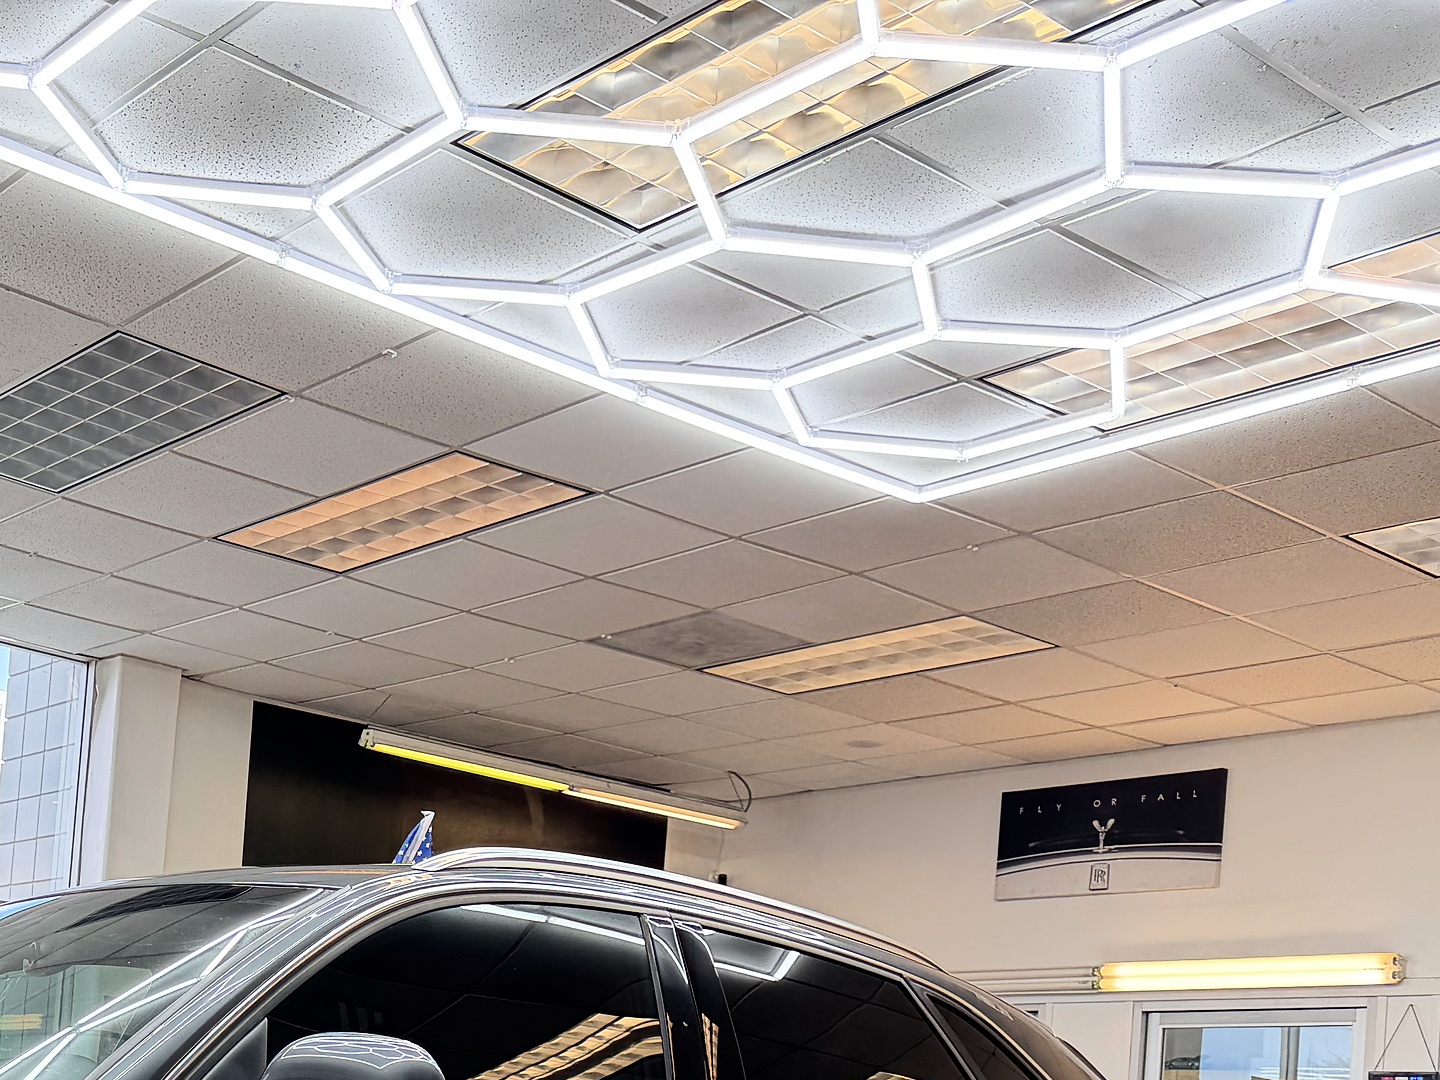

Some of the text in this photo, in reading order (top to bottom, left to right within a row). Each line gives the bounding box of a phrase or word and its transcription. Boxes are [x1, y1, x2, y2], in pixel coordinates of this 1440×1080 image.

[1019, 790, 1198, 815] FLY OR FALL
